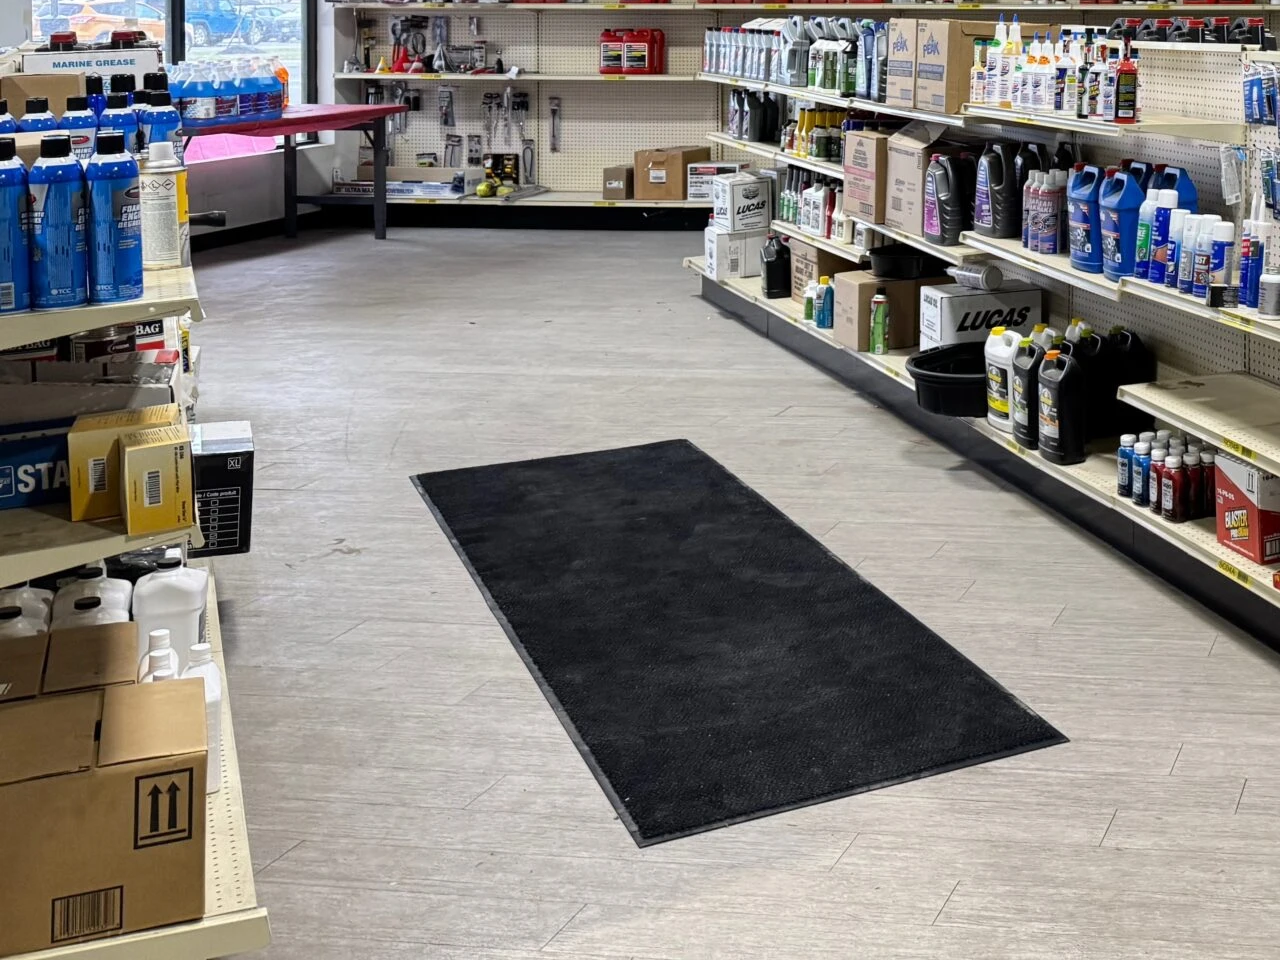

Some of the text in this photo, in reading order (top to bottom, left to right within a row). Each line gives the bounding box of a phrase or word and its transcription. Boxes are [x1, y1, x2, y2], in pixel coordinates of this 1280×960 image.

[892, 38, 909, 55] PEAK
[923, 41, 940, 58] PEAK
[52, 58, 136, 69] MARINE GREASE
[736, 200, 767, 216] LUCAS
[956, 306, 1031, 333] LUCAS
[135, 322, 161, 336] BAG
[230, 458, 241, 469] XL
